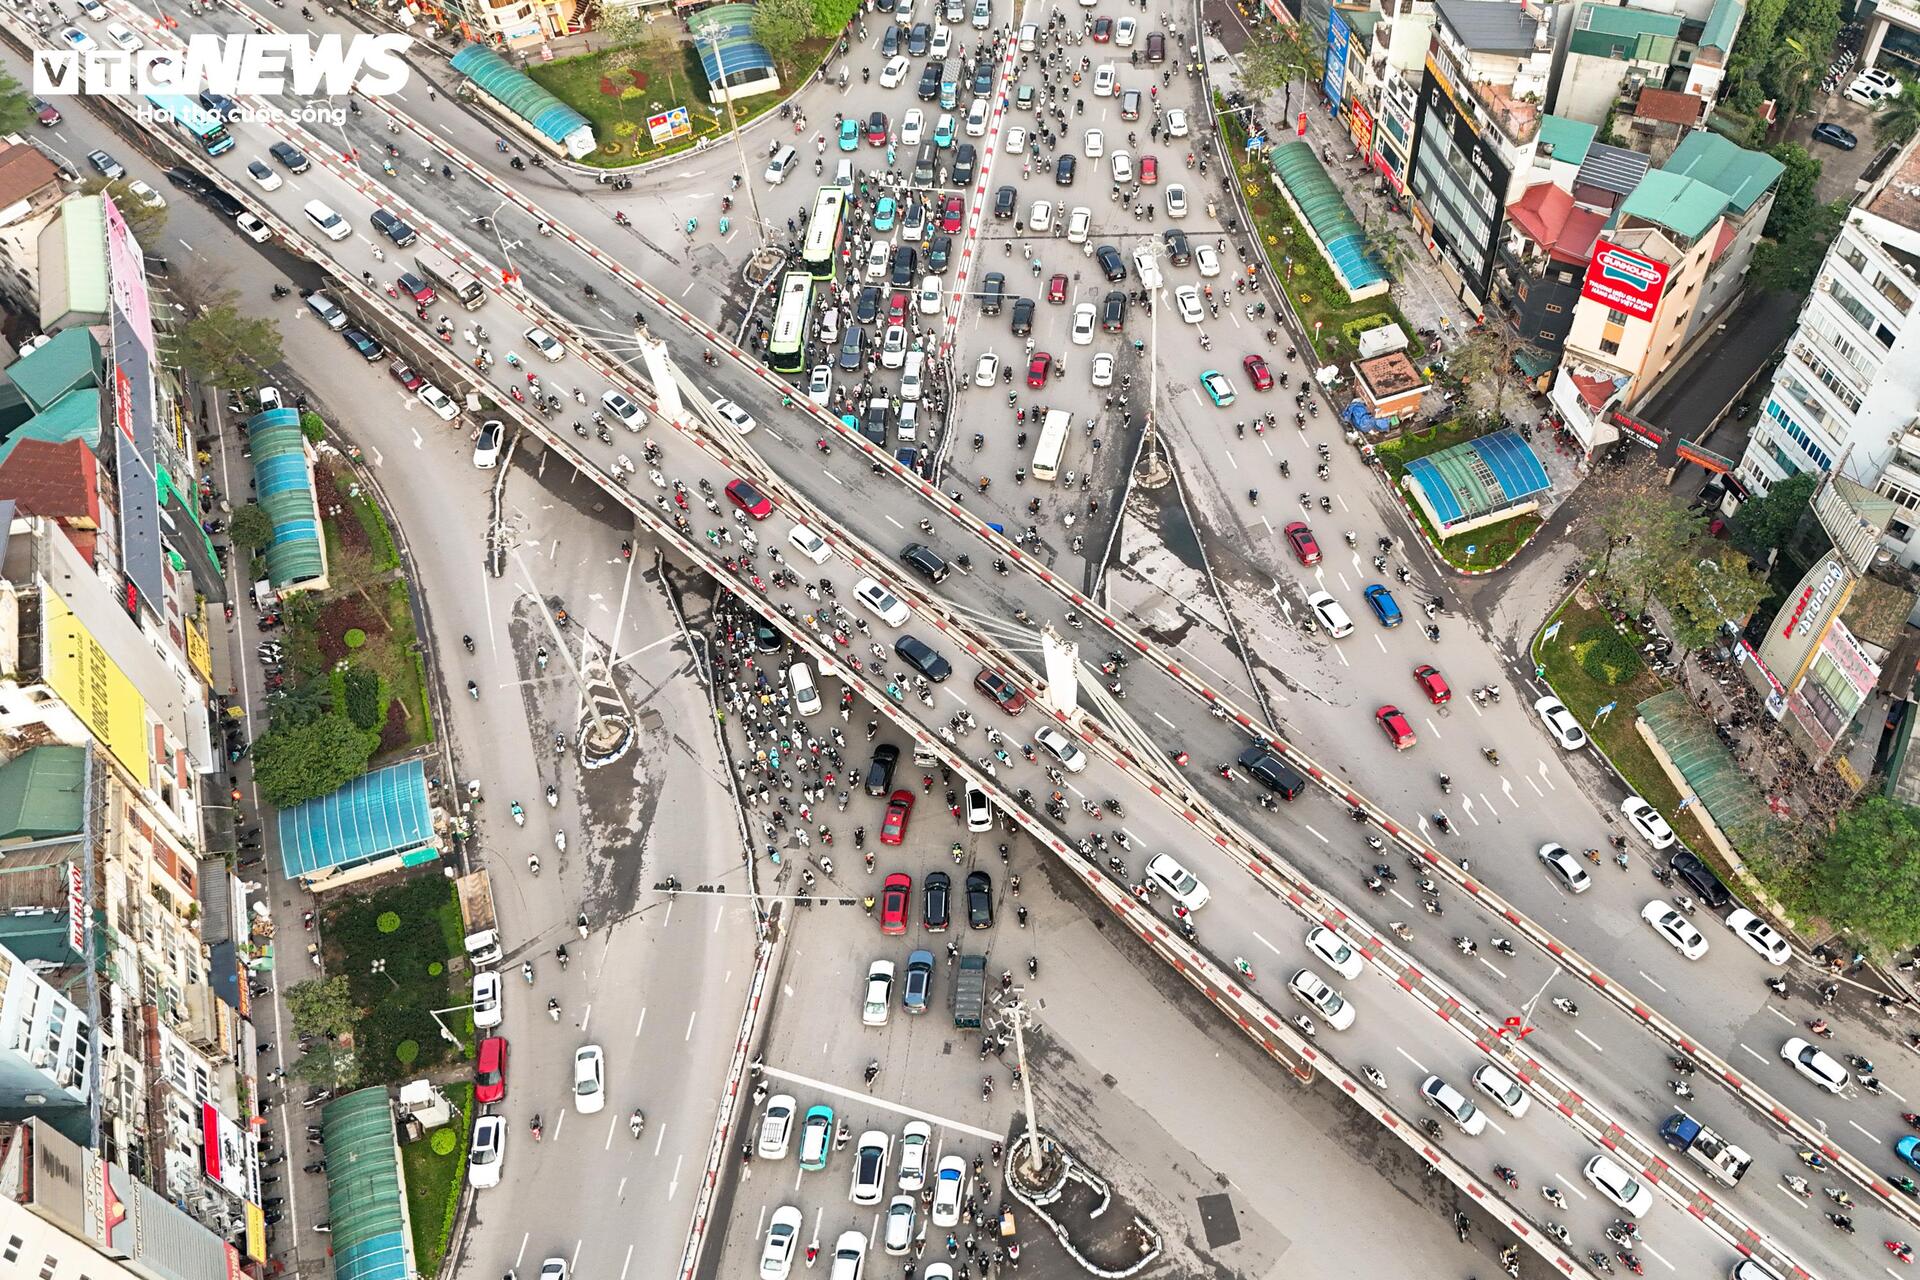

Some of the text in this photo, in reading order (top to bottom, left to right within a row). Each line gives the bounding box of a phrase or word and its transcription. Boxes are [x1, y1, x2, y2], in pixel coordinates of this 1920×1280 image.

[1636, 434, 1659, 450] TOWER
[1859, 651, 1873, 667] MAY
[89, 639, 109, 740] 0982 05 05 05
[1817, 685, 1846, 723] VESTON
[72, 896, 83, 919] HÀ
[74, 921, 83, 948] BIA
